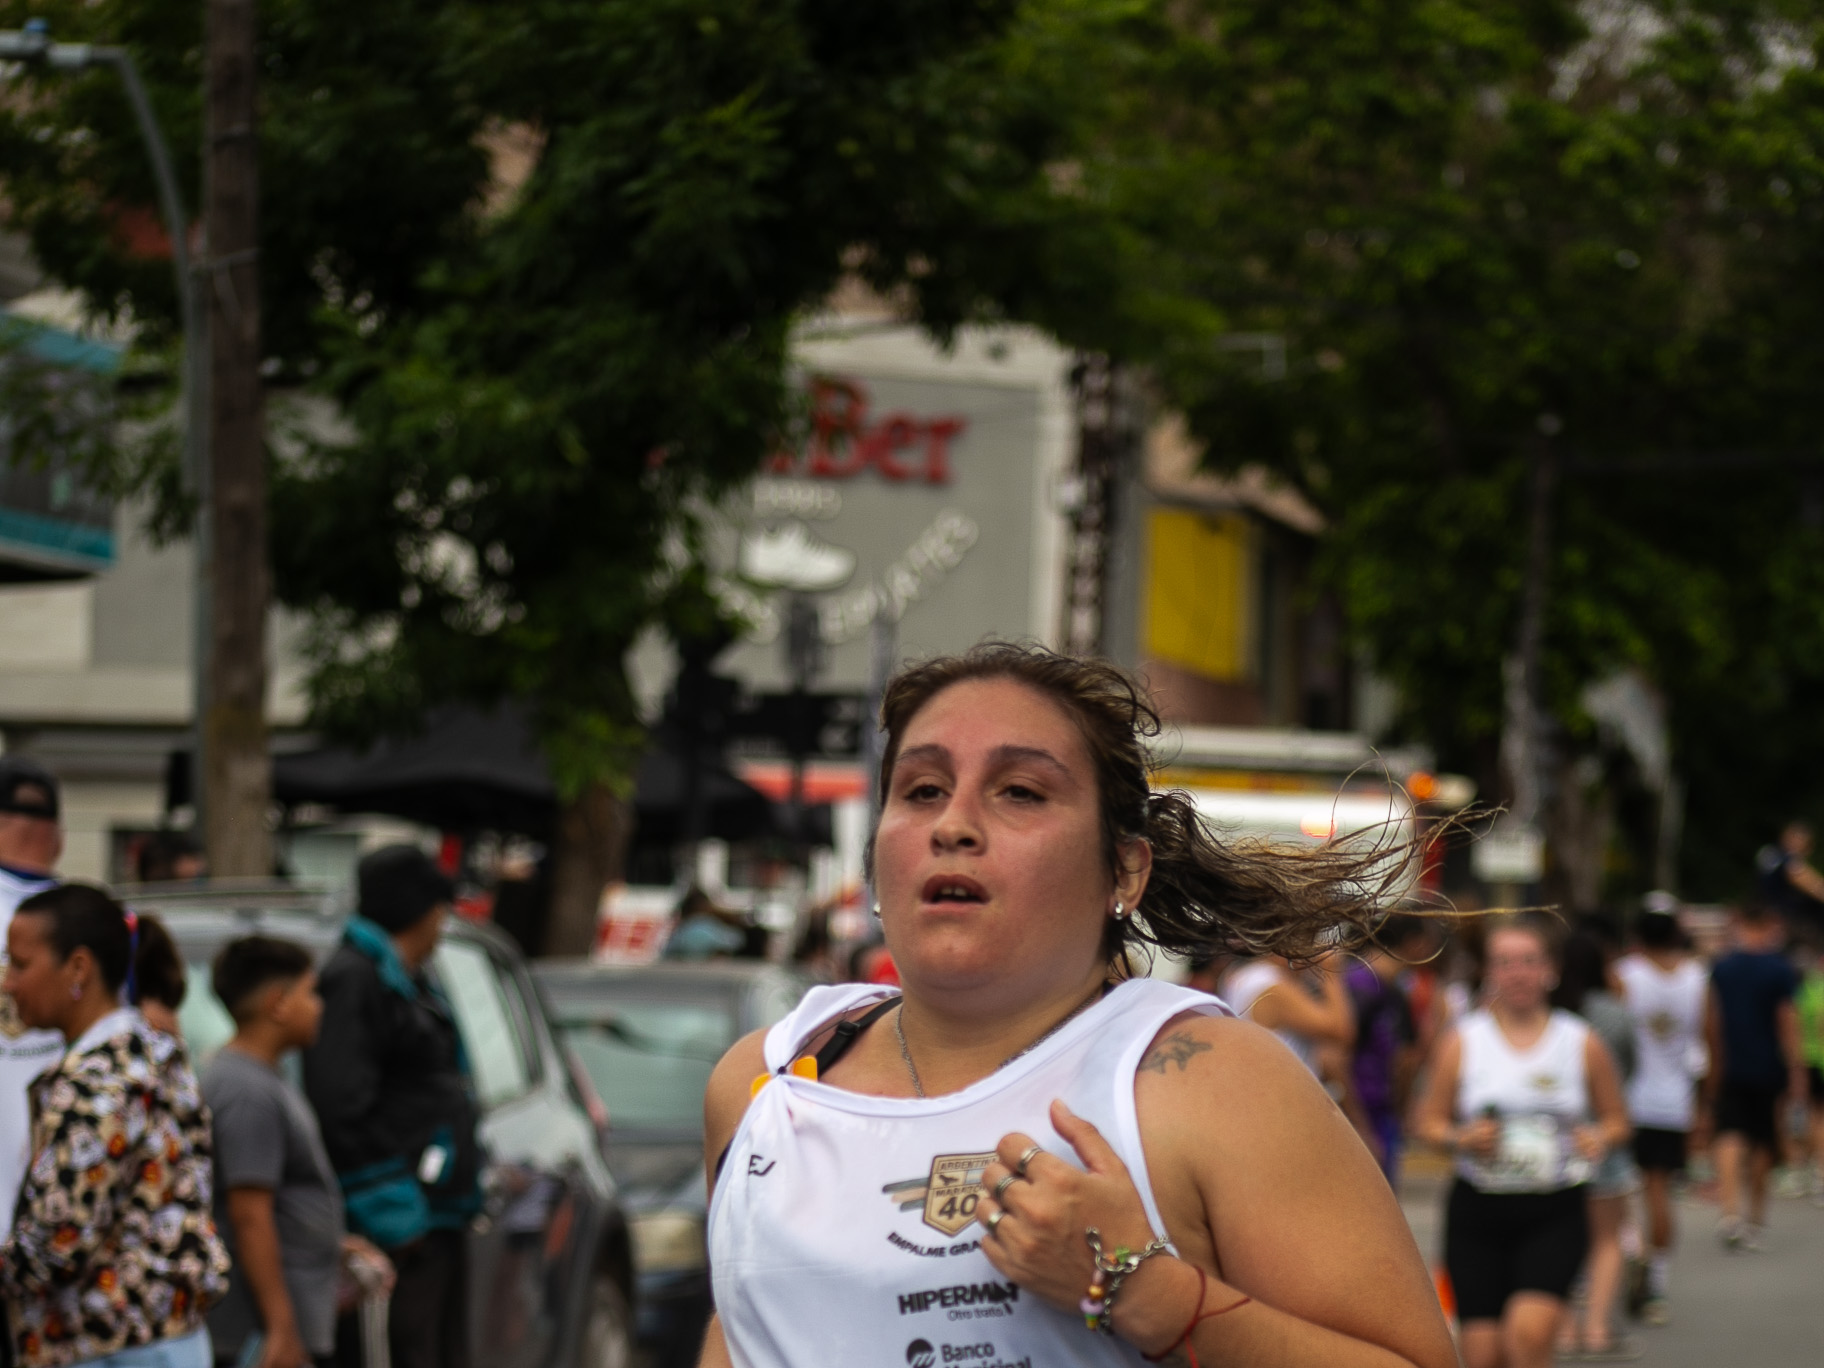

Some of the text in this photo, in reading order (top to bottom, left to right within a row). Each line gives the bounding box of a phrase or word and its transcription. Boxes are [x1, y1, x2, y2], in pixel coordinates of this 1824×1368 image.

[938, 1193, 980, 1220] 40
[887, 1232, 946, 1258] EMPALME
[940, 1342, 996, 1363] Banco
